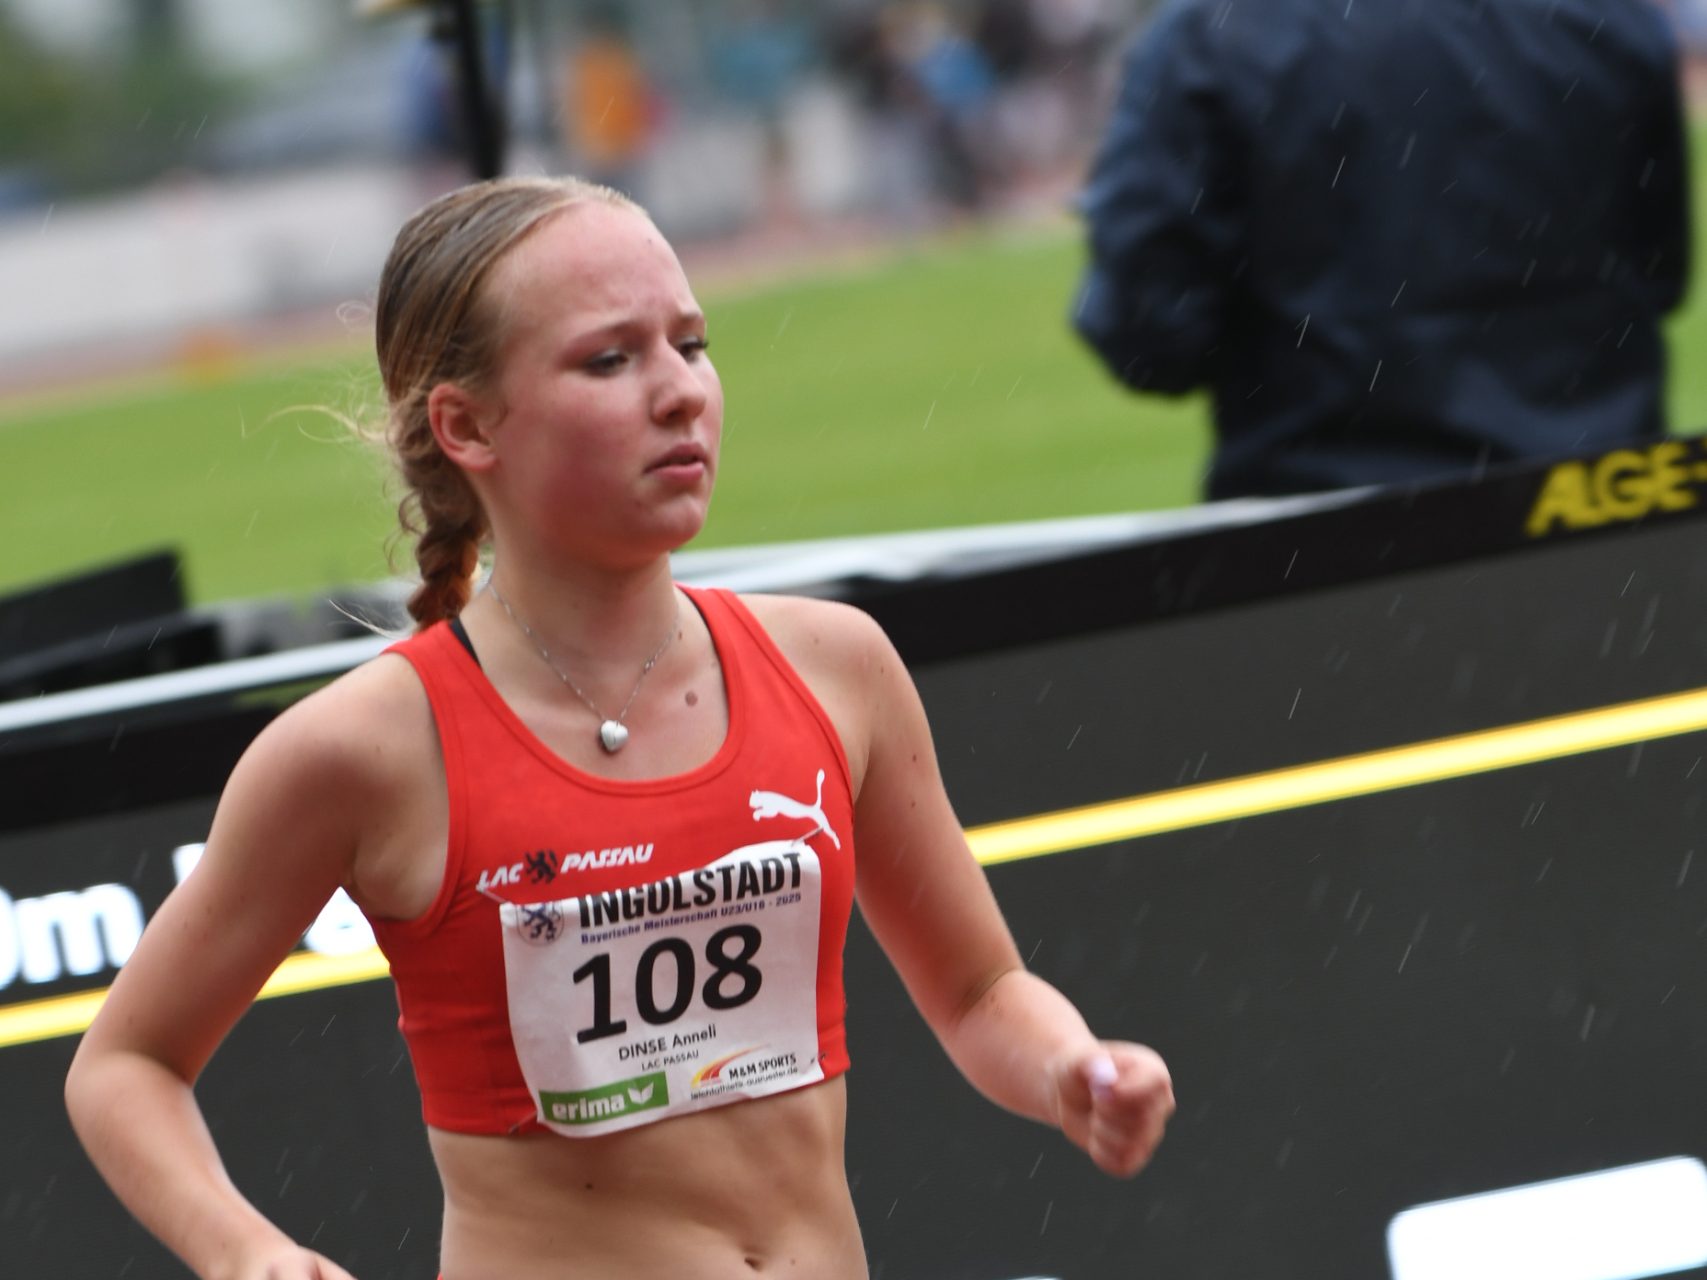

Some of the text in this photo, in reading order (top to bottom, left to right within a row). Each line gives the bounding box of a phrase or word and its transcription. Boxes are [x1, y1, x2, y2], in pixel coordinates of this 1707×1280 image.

[476, 843, 654, 892] LAC PASSAU
[577, 852, 801, 929] INGOLSTADT
[580, 924, 641, 945] Bayerische
[643, 909, 718, 932] Meisterschaft
[573, 924, 763, 1045] 108
[619, 1023, 717, 1061] DINSE Anneli
[641, 1049, 699, 1071] LAC PASSAU
[729, 1053, 797, 1079] M&M SPORTS
[552, 1094, 625, 1120] erima
